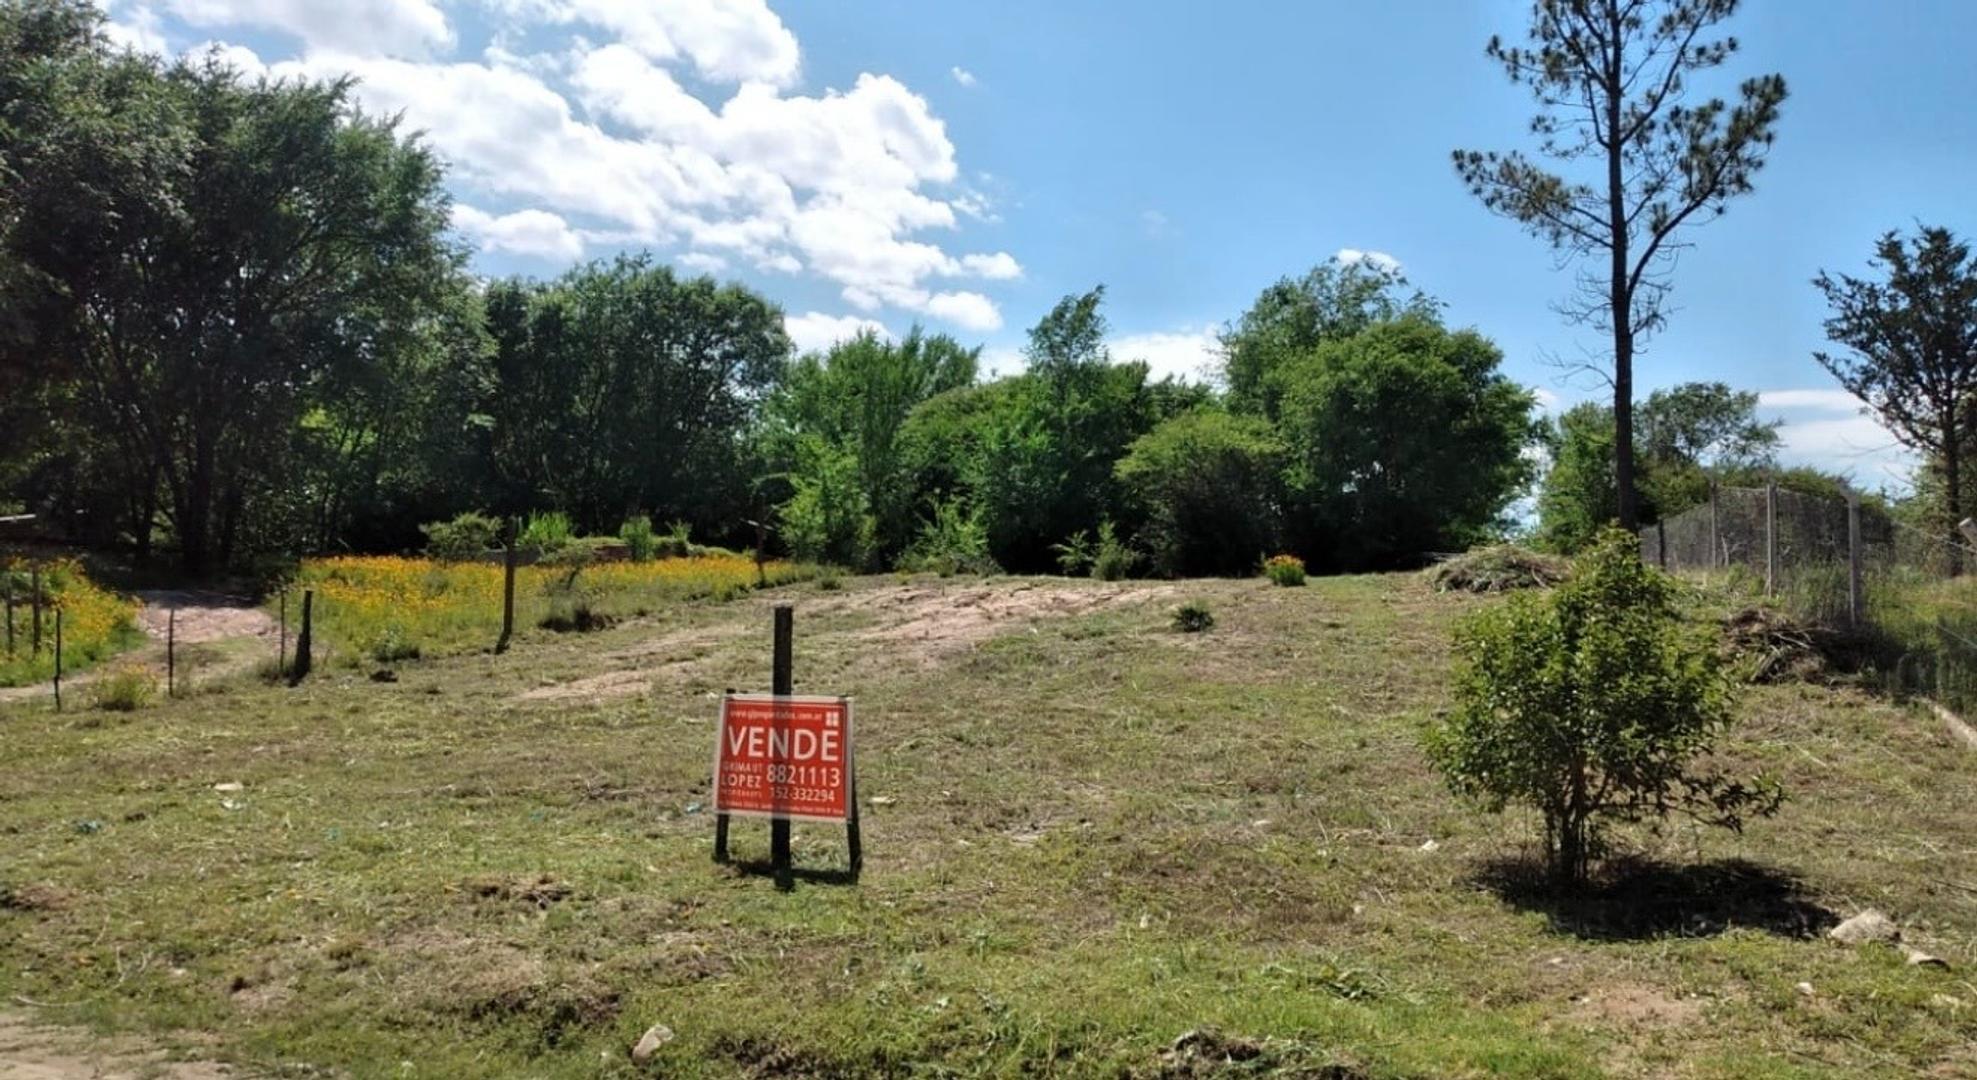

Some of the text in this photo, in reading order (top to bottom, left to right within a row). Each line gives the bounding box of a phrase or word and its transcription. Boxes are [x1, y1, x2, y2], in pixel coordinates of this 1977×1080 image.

[728, 726, 839, 761] VENDE
[720, 773, 762, 788] LOPEZ
[766, 763, 841, 788] 8821113
